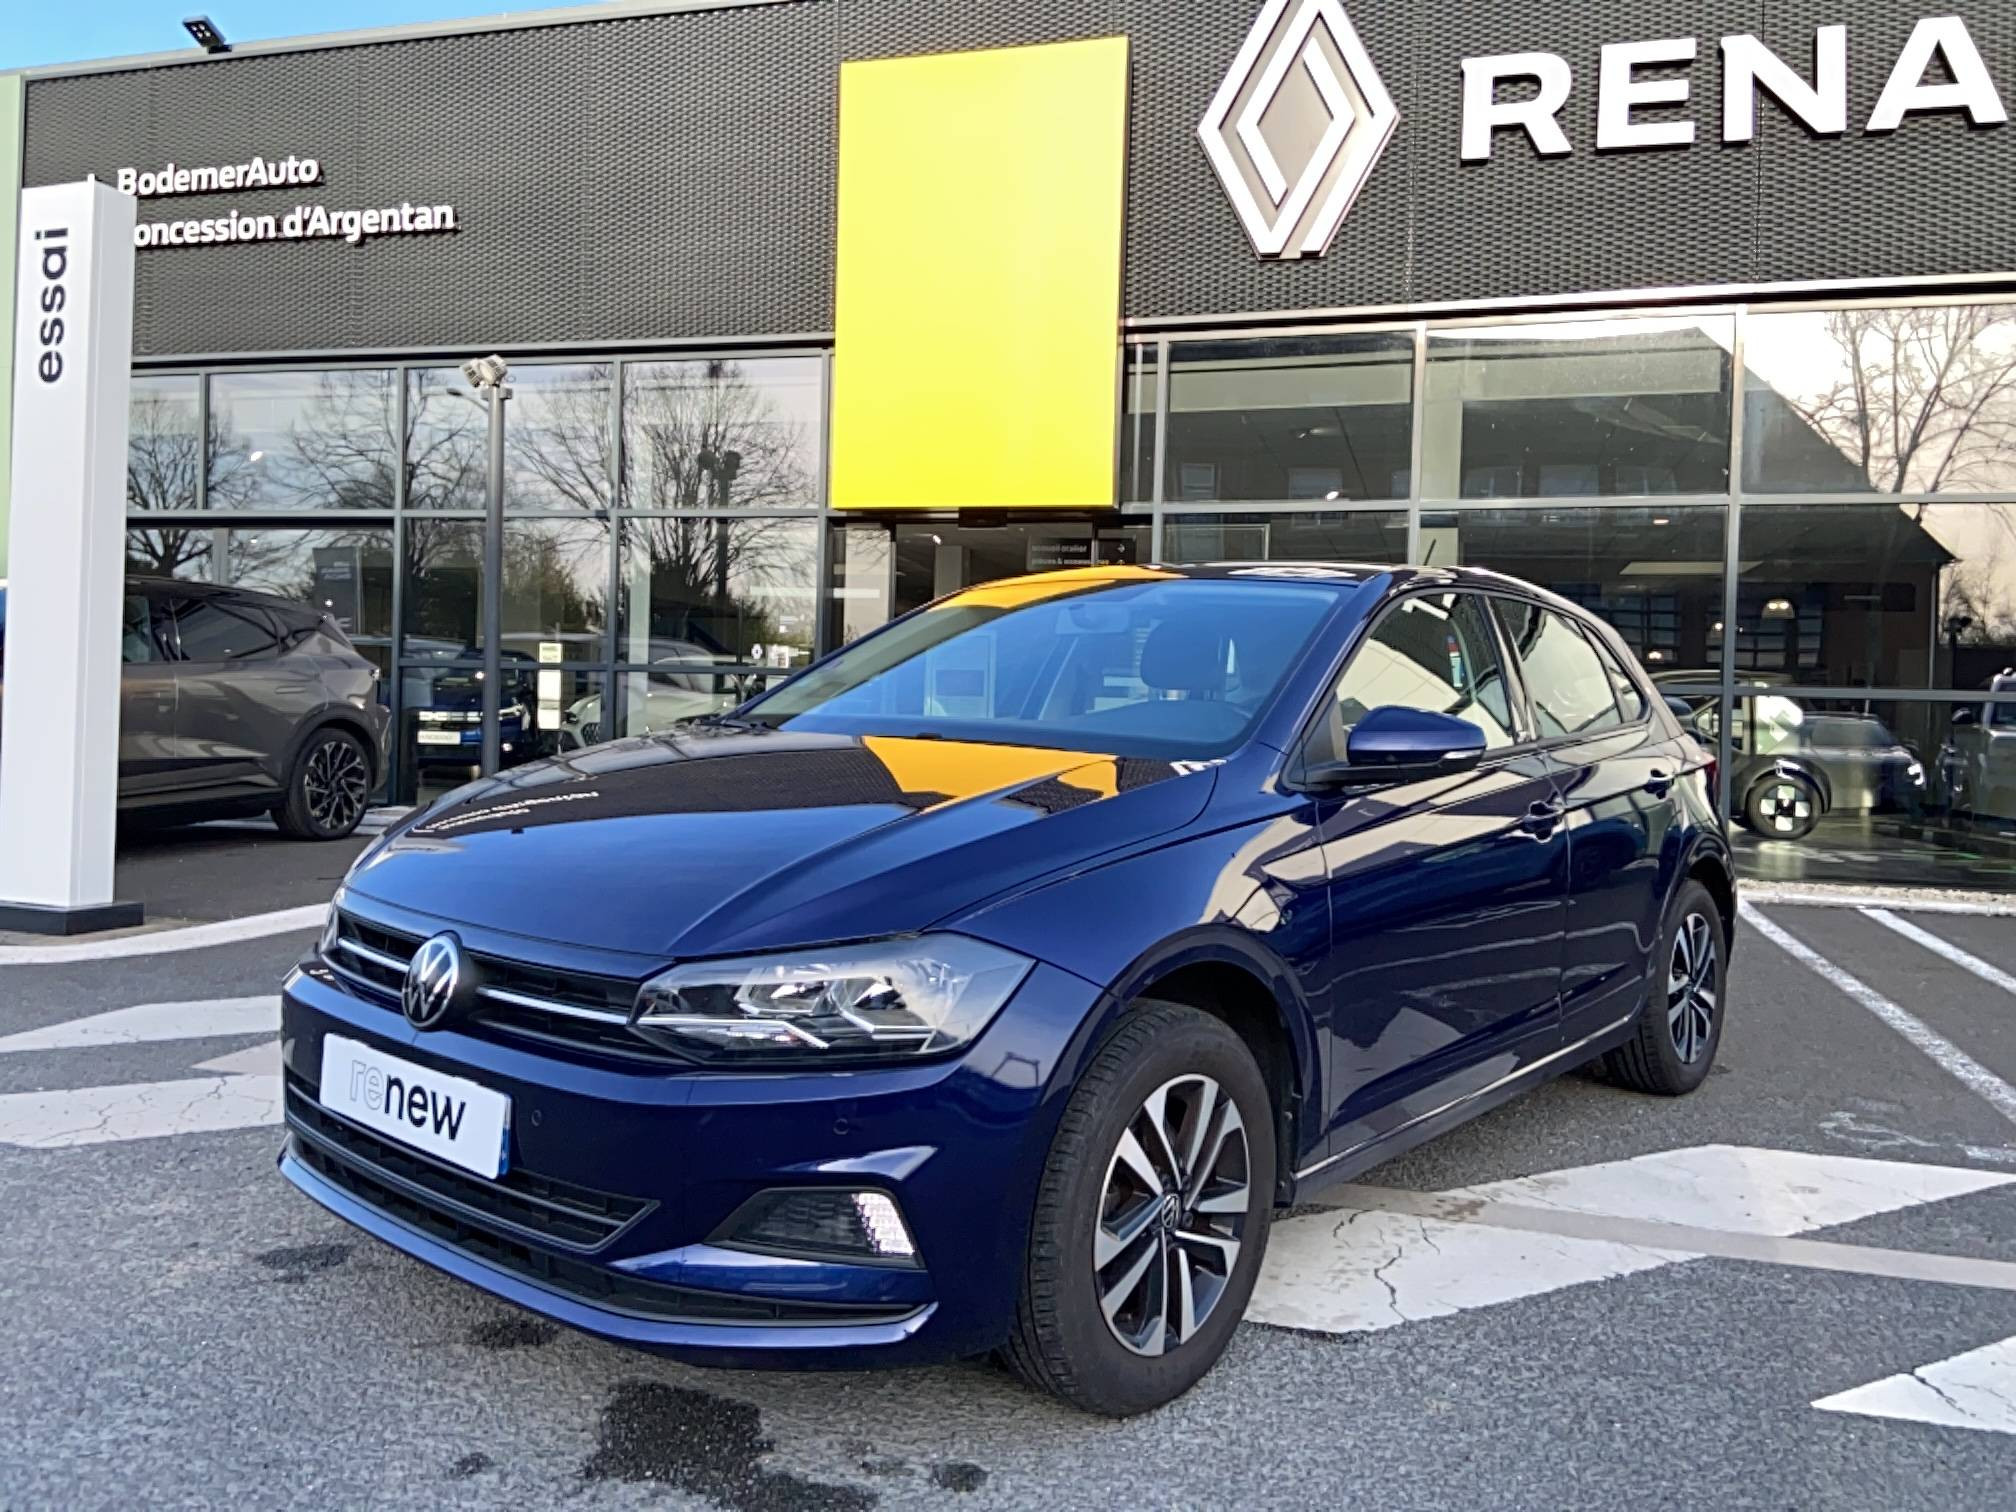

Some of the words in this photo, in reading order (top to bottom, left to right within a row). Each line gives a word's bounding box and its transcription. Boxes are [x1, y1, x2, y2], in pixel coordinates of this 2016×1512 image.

[1460, 15, 2009, 161] RENA
[117, 155, 321, 197] BodemerAuto
[134, 209, 277, 248] oncession
[282, 201, 456, 243] d'Argentan
[34, 227, 69, 384] essai
[349, 1059, 467, 1142] renew
